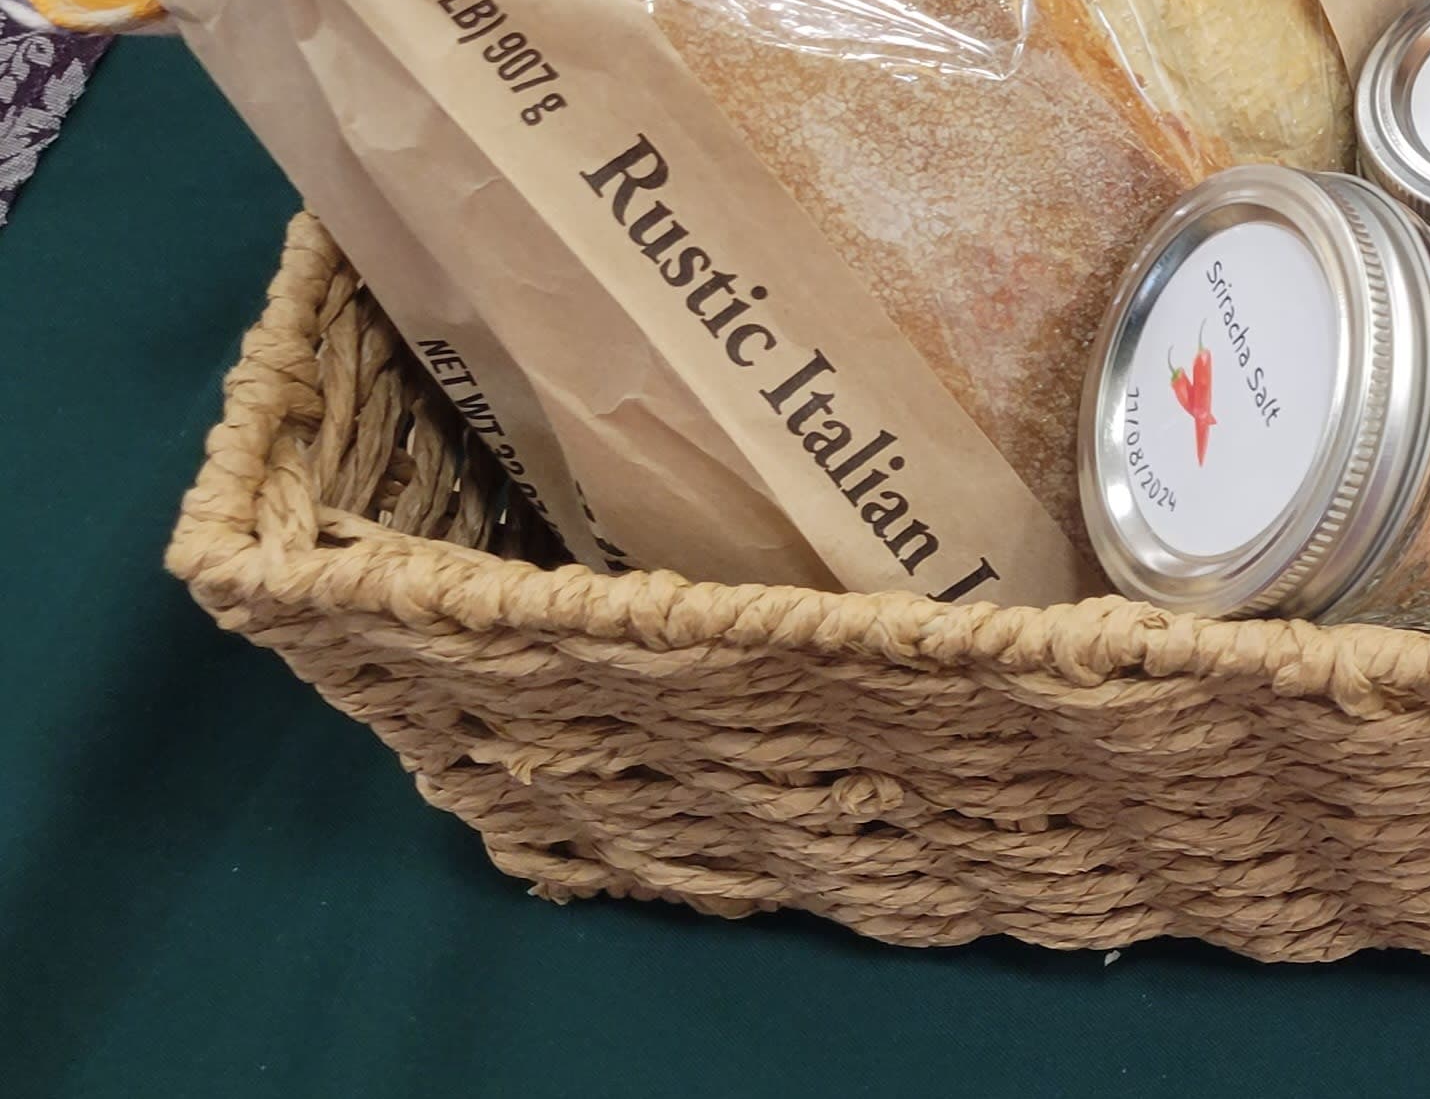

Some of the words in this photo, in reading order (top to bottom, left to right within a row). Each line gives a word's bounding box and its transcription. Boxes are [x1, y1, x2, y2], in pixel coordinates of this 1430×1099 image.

[482, 32, 560, 93] 907
[520, 92, 568, 126] g
[418, 339, 477, 387] NET
[455, 392, 505, 437] WT
[579, 133, 778, 367] Rustic
[759, 348, 940, 577] Italian
[1206, 261, 1250, 368] Sriracha
[1247, 367, 1281, 427] Salt
[1127, 387, 1178, 512] 11/08/2024
